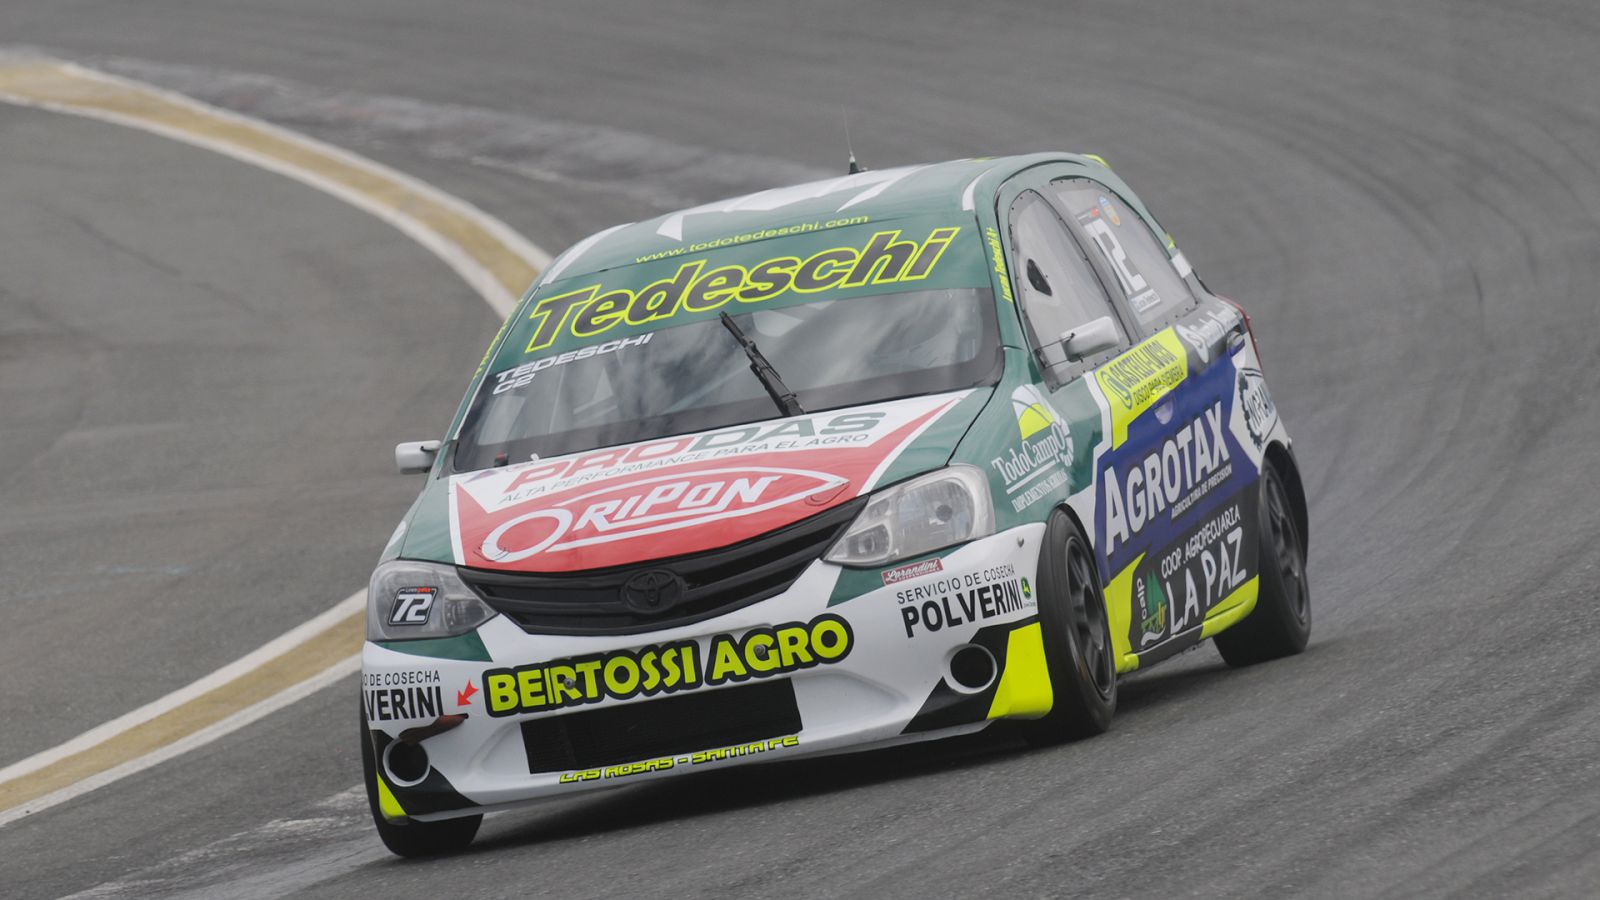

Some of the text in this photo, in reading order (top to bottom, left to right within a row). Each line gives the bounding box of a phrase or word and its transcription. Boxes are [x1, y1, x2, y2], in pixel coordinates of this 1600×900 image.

[635, 214, 869, 264] www.todotedeschi.com
[525, 226, 961, 354] Tedeschi
[495, 332, 655, 383] TEDESCHI
[492, 373, 536, 395] C2
[497, 433, 869, 505] ALTA PERFORMANCE PARA EL AGRO
[503, 411, 887, 495] PRODAS
[1103, 400, 1231, 557] AGROTAX
[896, 563, 1015, 605] SERVICIO DE COSECHA
[1166, 526, 1247, 635] LA PAZ
[392, 593, 433, 622] 72
[900, 579, 1023, 639] POLVERINI
[369, 673, 382, 687] DE
[384, 669, 441, 686] COSECHA
[487, 619, 849, 713] BERTOSSI AGRO
[363, 685, 444, 721] VERINI
[559, 769, 601, 784] LAS
[605, 756, 674, 780] ROSAS
[692, 741, 766, 765] SANTA
[769, 734, 799, 751] FE
